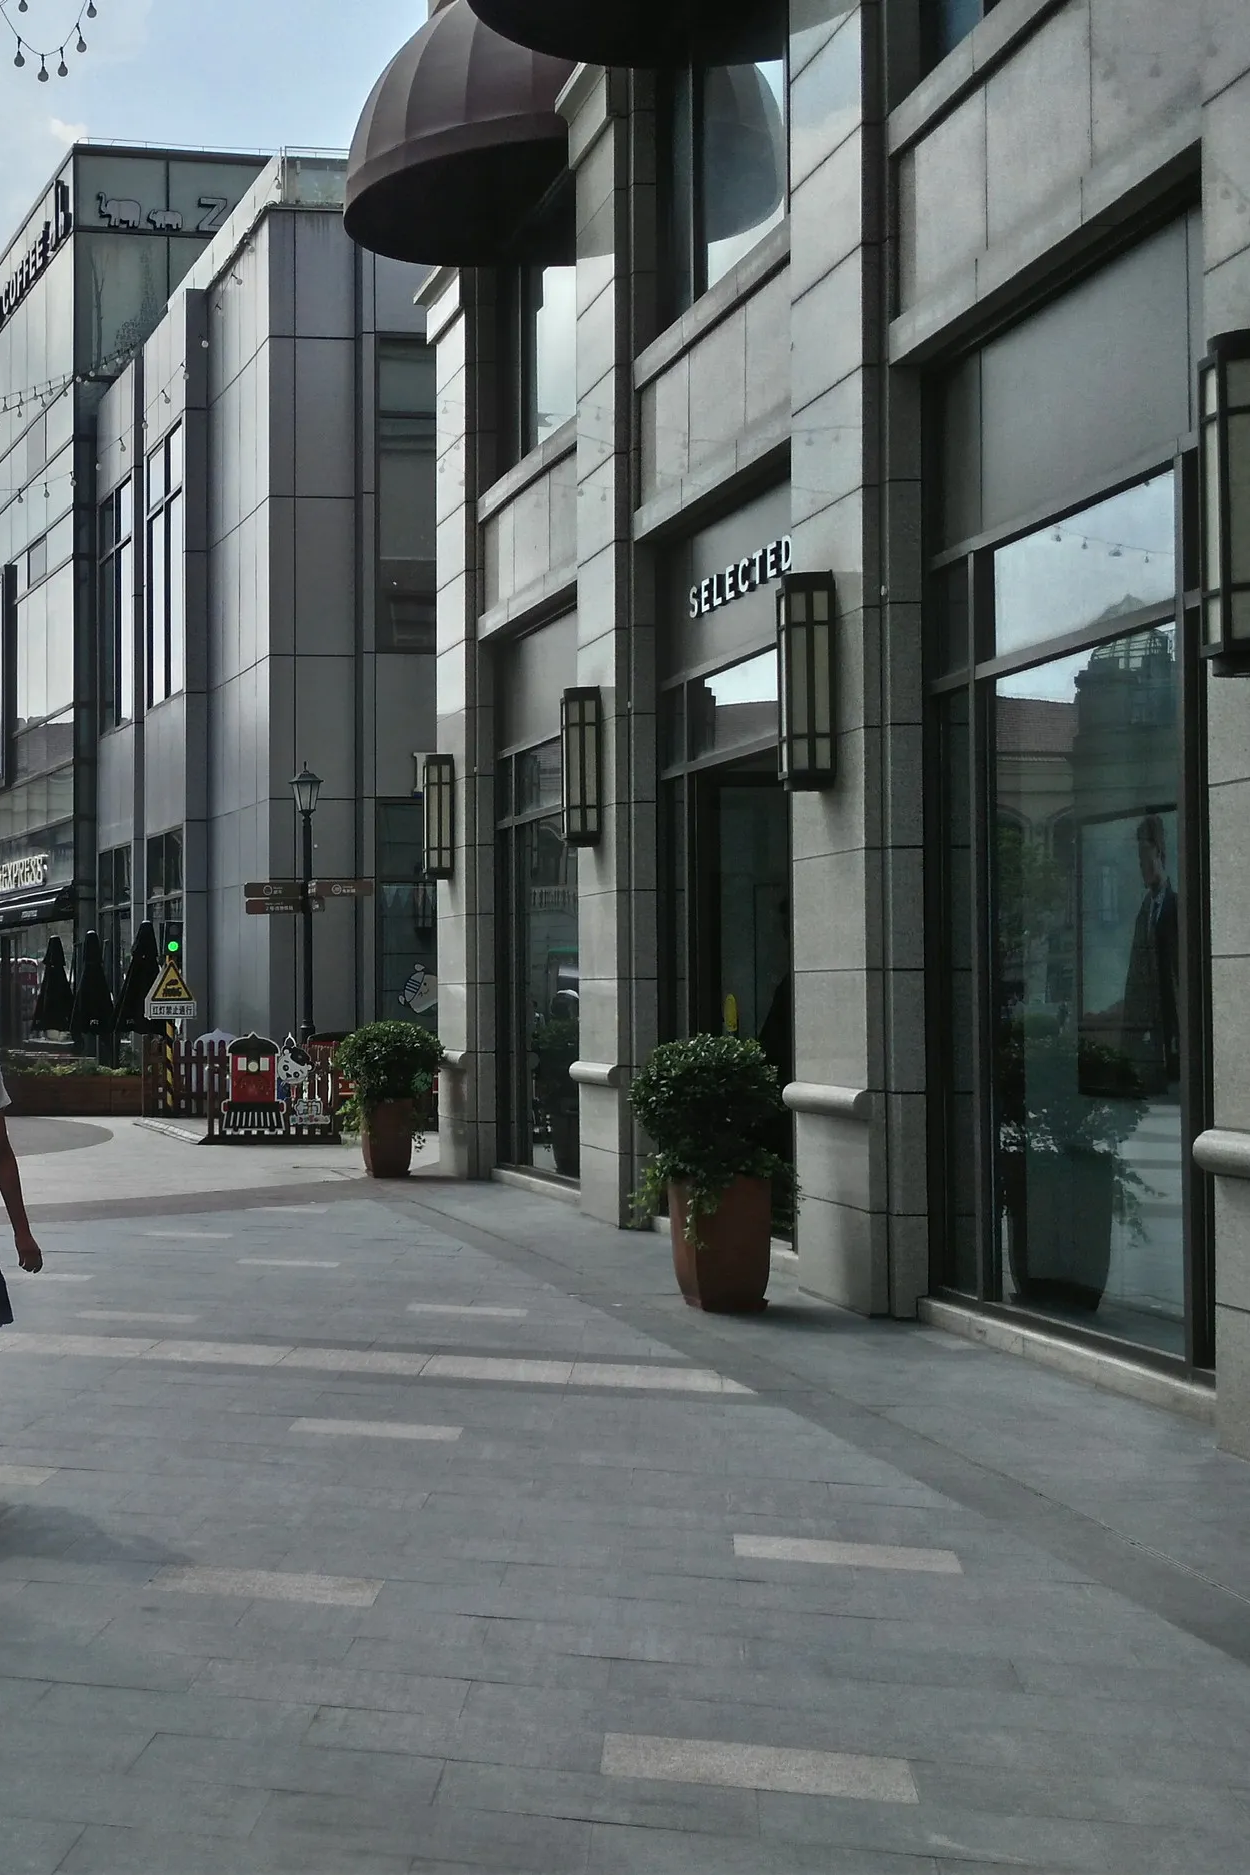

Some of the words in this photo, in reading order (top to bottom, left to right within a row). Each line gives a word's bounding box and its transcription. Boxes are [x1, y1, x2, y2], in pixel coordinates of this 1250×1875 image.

[2, 240, 44, 316] COFFEE
[689, 534, 792, 619] SELECTED
[152, 1005, 192, 1015] 红灯禁止通行
